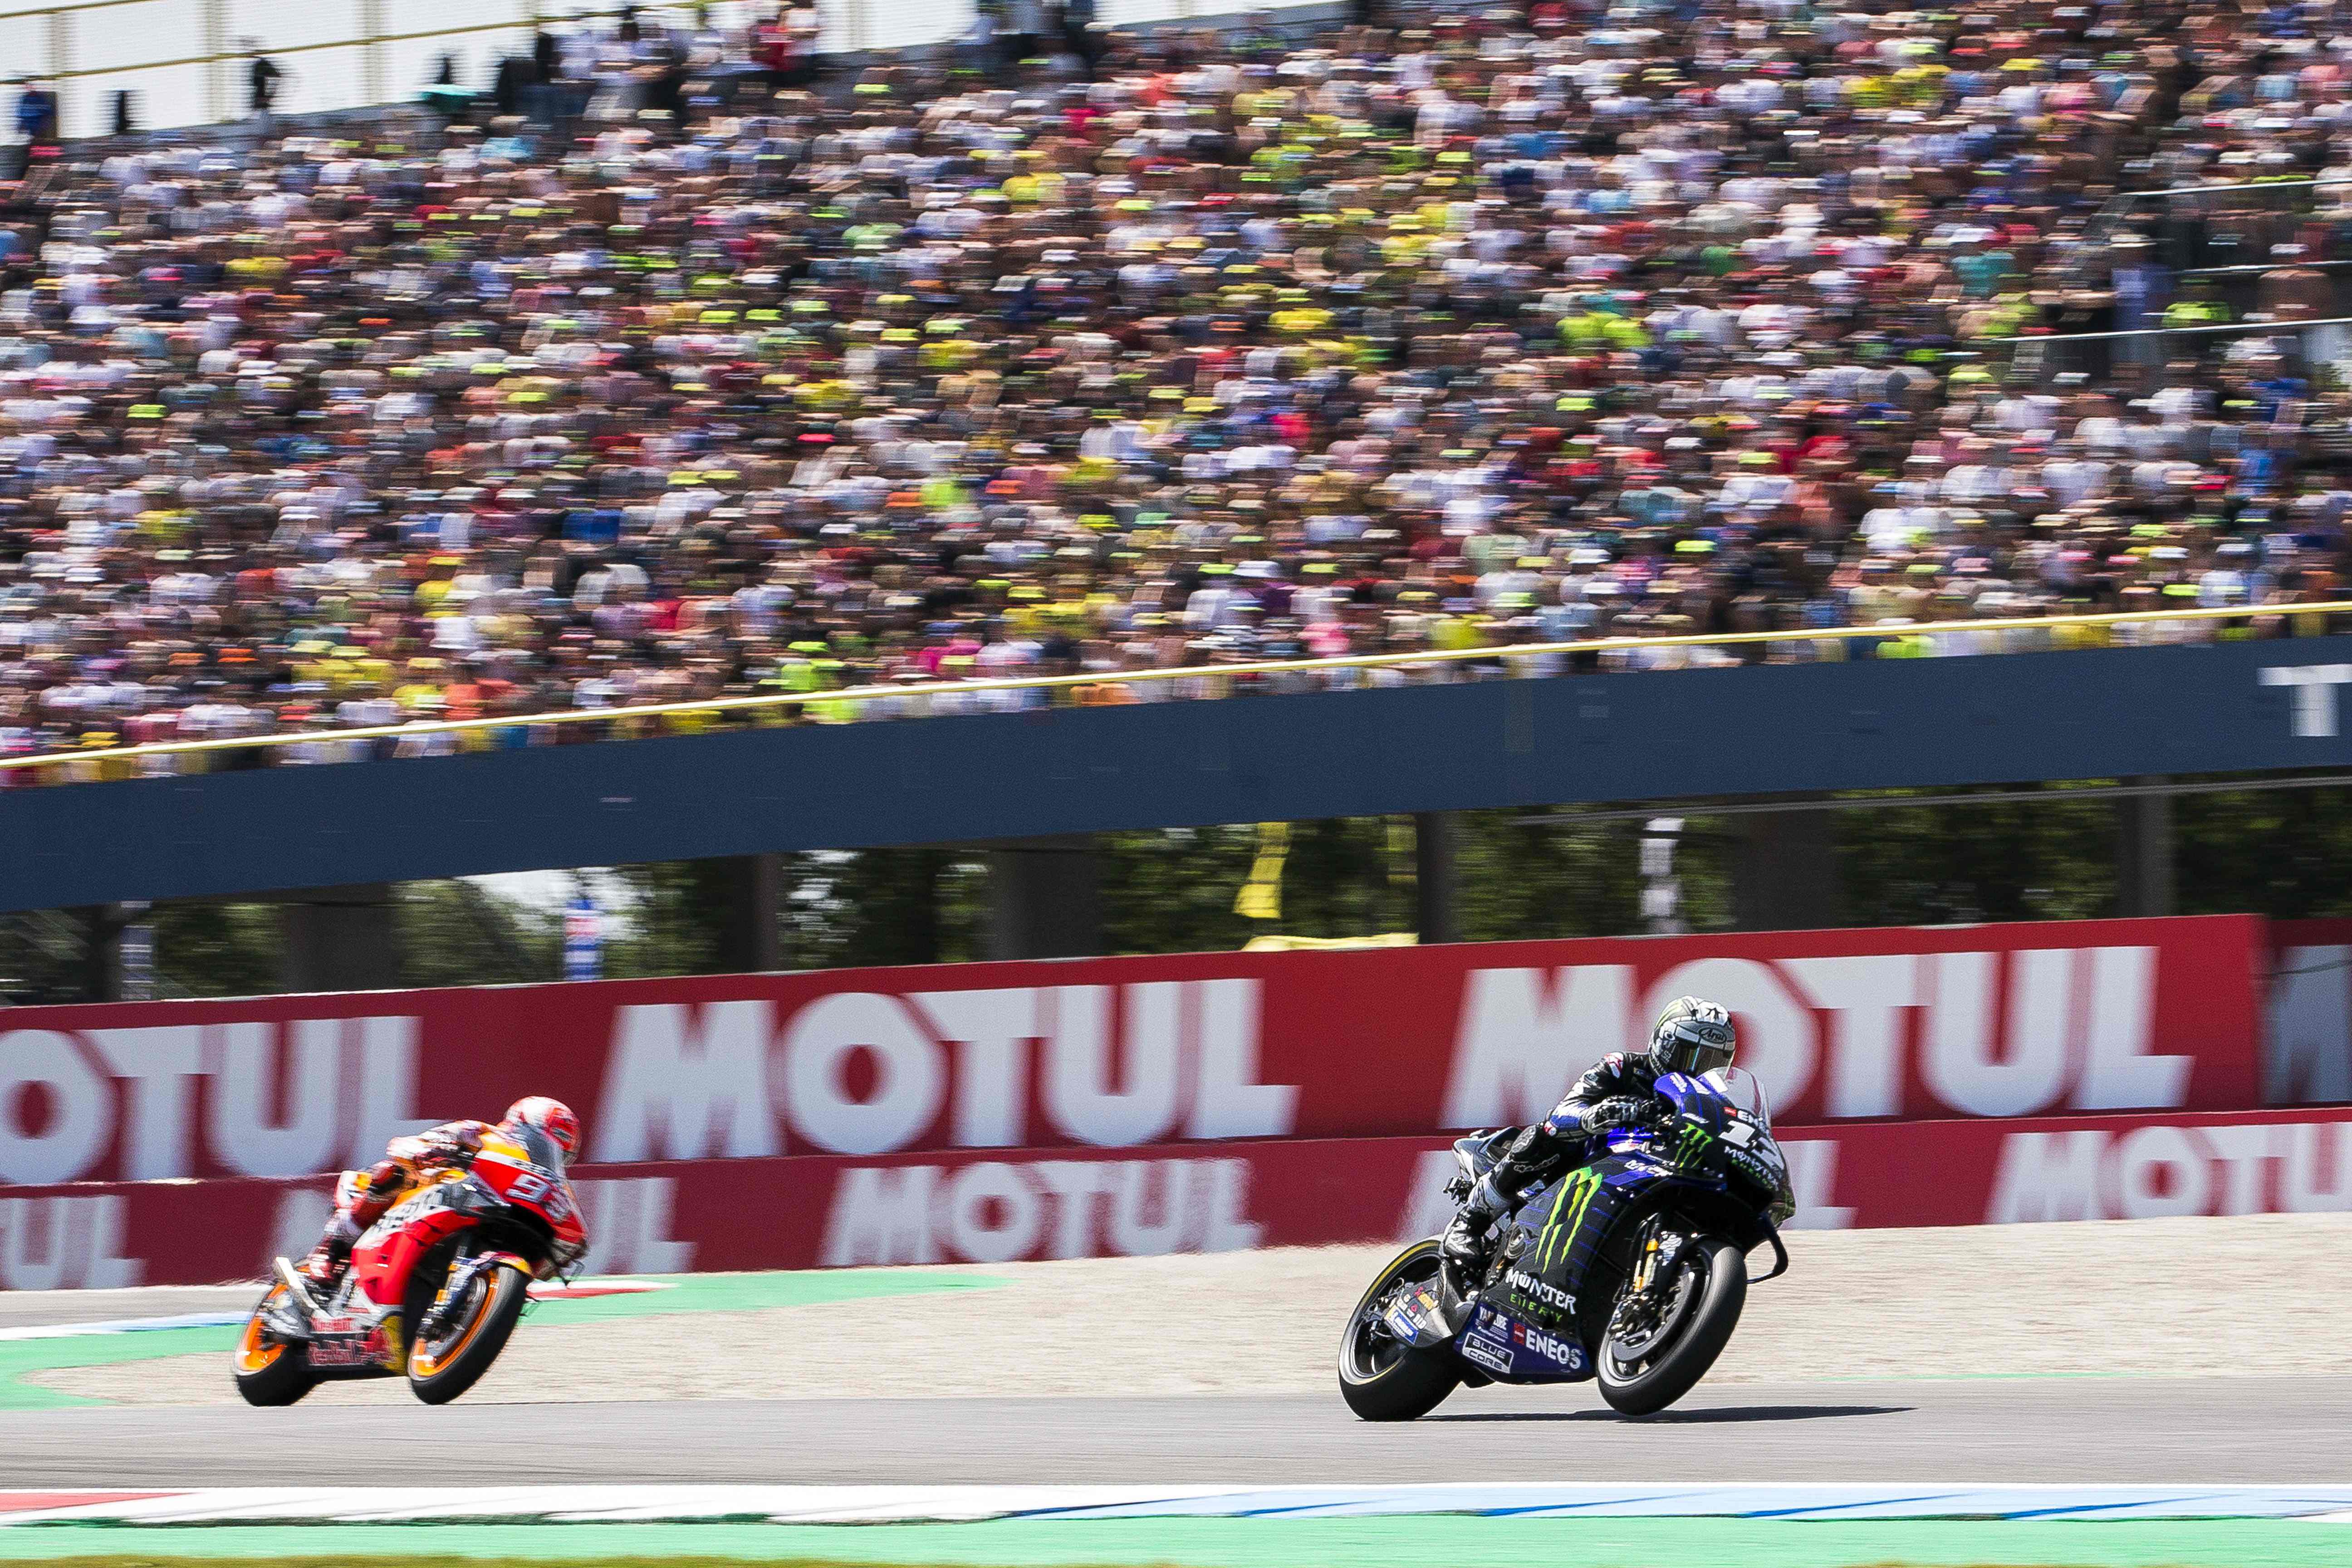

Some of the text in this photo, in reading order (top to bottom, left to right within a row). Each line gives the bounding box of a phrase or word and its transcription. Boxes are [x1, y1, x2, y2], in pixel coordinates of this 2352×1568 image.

[1439, 945, 2196, 1129] MOTUL
[587, 978, 1302, 1161] MOTUL
[505, 1173, 572, 1221] 93
[819, 1157, 1268, 1266] MOTUL
[1505, 1268, 1577, 1315] MONSTER
[1509, 1293, 1562, 1322] ENERY
[1469, 1349, 1503, 1370] CORE
[1472, 1338, 1506, 1359] BLUE
[1526, 1329, 1582, 1369] ENEOS
